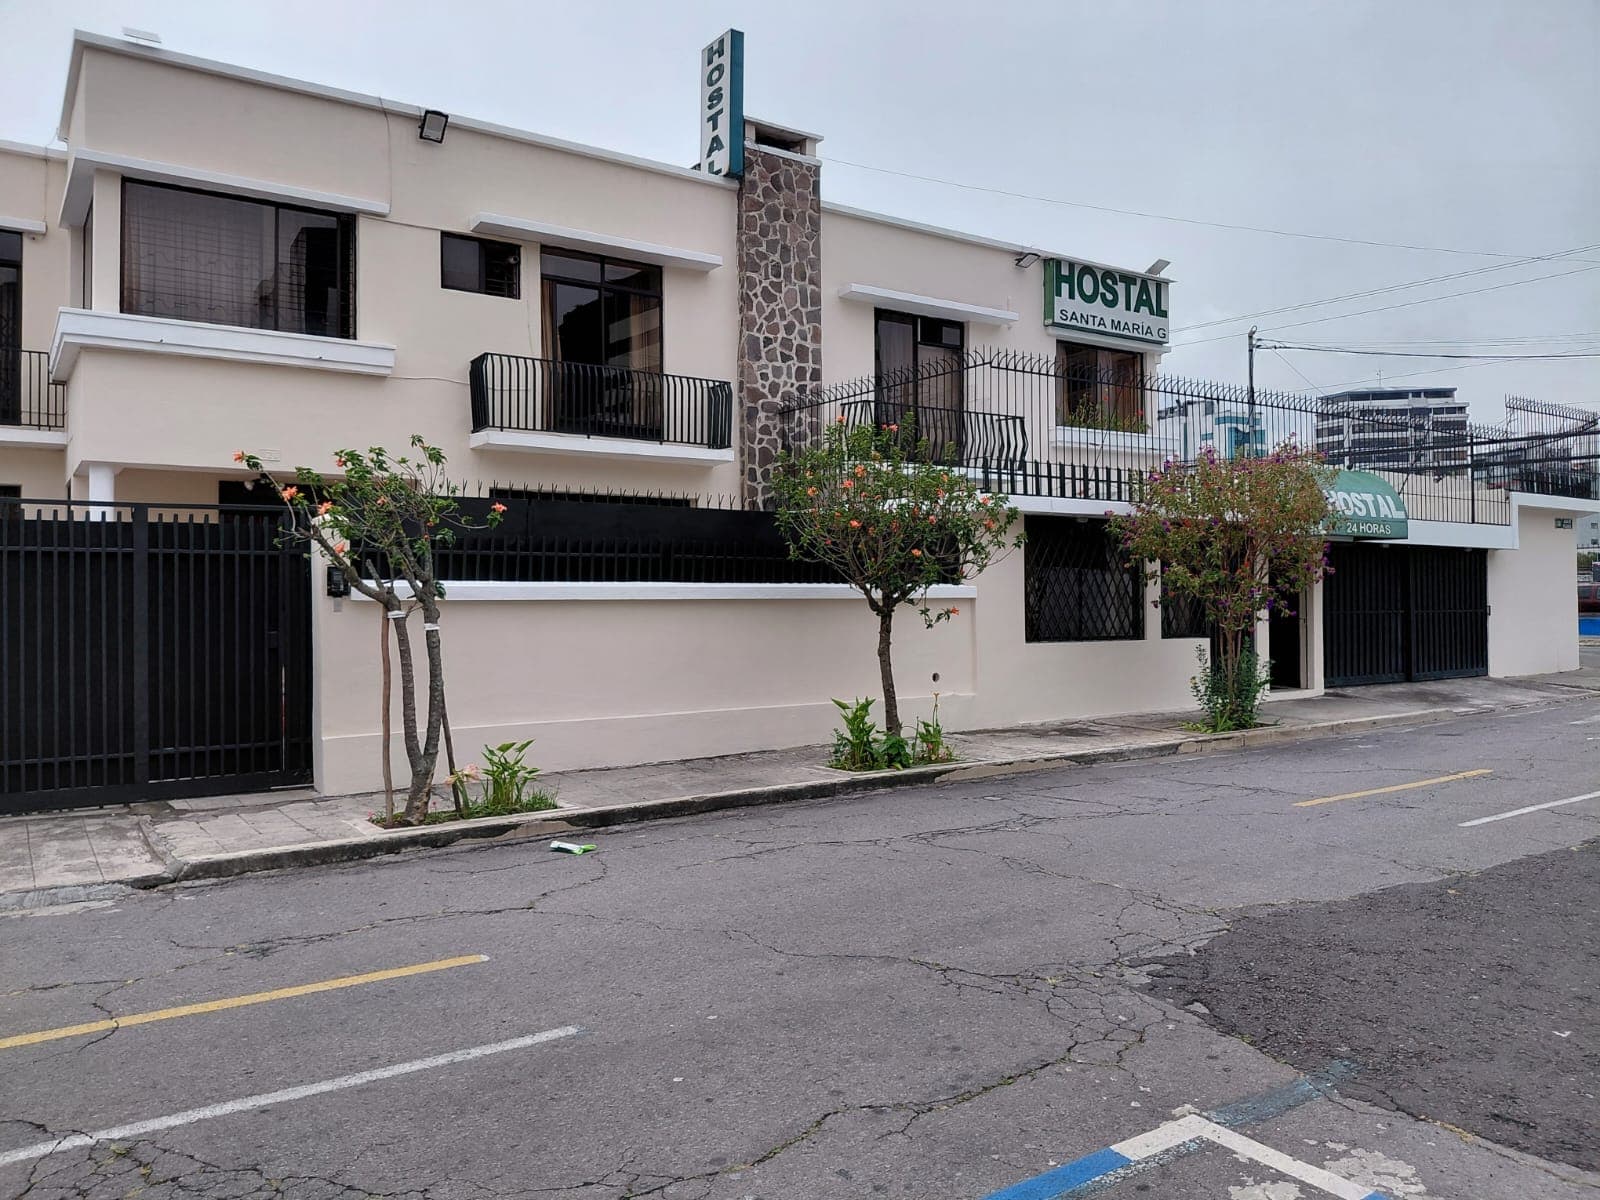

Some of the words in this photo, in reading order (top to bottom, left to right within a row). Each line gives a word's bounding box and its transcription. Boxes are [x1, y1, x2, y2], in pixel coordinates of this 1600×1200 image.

[706, 37, 725, 176] HOSTAL
[1055, 260, 1168, 319] HOSTAL
[1060, 309, 1107, 329] SANTA
[1110, 319, 1154, 338] MARÍA
[1157, 327, 1167, 339] G
[1347, 522, 1357, 533] 24
[1360, 523, 1391, 535] HORAS
